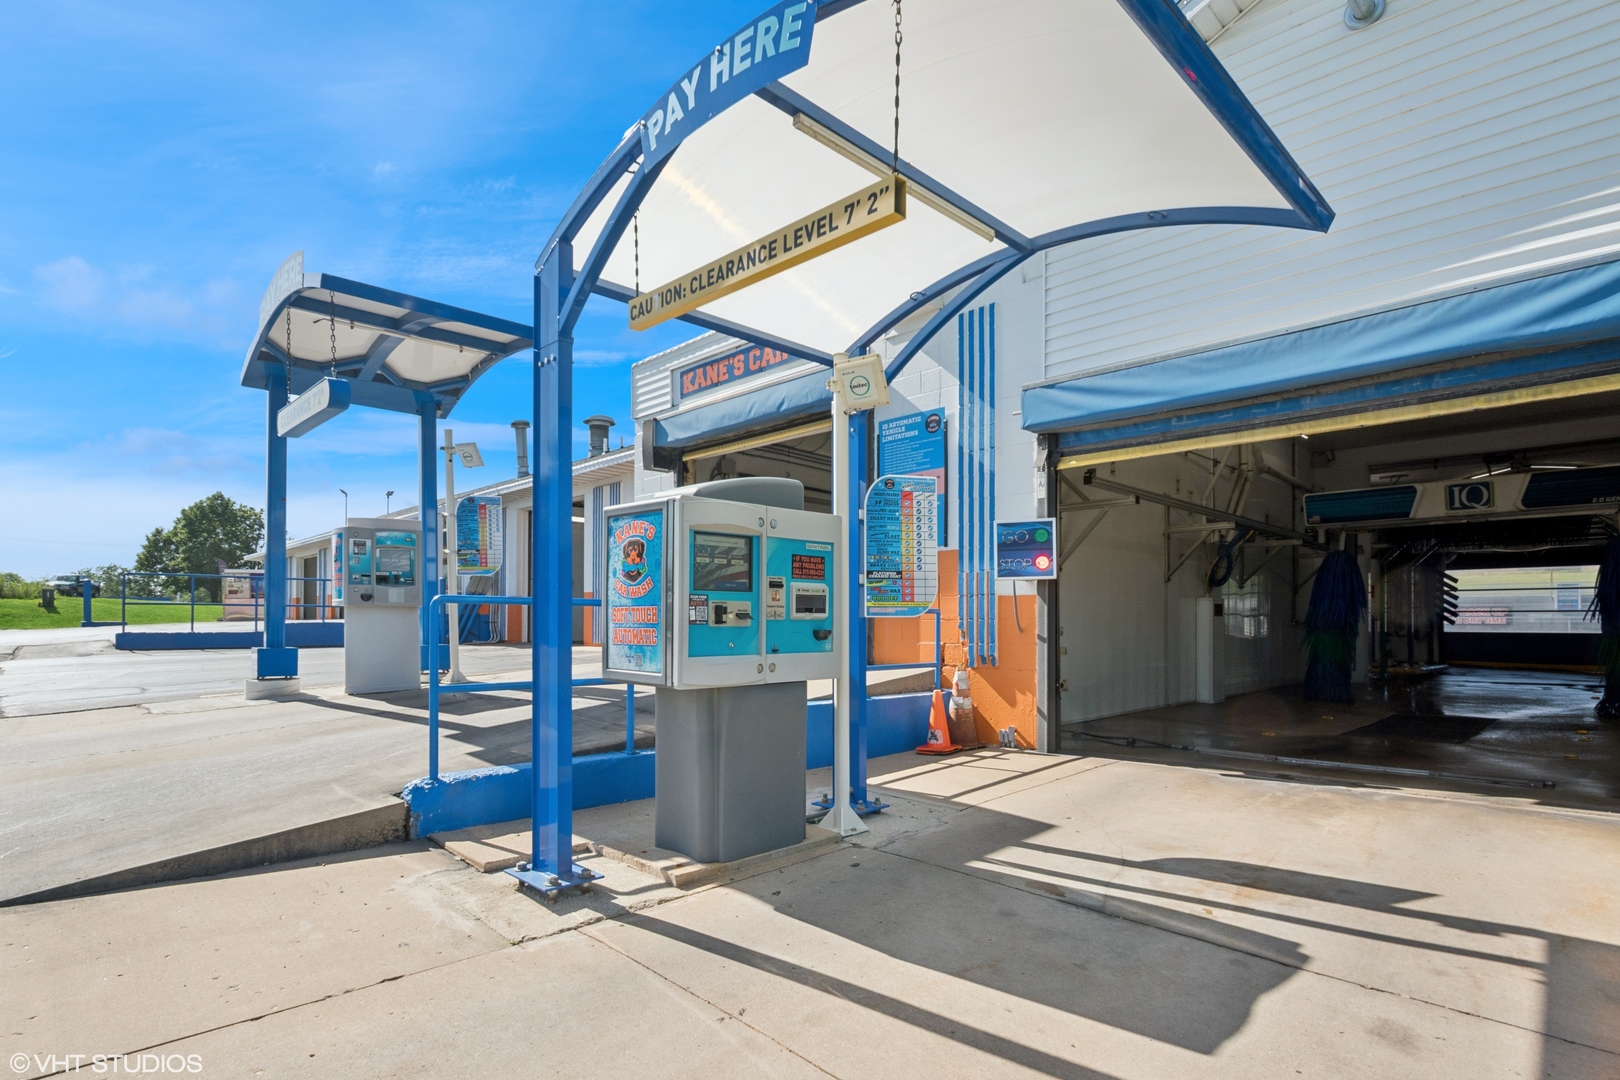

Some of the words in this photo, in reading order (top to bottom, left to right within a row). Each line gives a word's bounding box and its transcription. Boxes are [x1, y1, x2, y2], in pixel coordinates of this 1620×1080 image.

[646, 65, 702, 151] PAY
[710, 1, 807, 93] HERE
[690, 238, 778, 294] CLEARANCE
[783, 212, 839, 254] LEVEL
[277, 254, 303, 296] HERE
[682, 353, 745, 395] KANE'S
[850, 382, 868, 390] Unitec
[882, 426, 906, 436] VEHICLE
[889, 416, 922, 428] AUTOMATIC
[882, 430, 918, 442] LIMITATIONS
[1451, 484, 1491, 509] IQ
[614, 520, 656, 545] KANE'S
[1002, 530, 1028, 543] GO
[1000, 558, 1032, 570] STOP
[614, 578, 628, 597] CAR
[629, 576, 654, 599] WASH
[612, 606, 629, 624] SOFT
[630, 606, 658, 624] TOUCH
[612, 627, 658, 646] AUTOMATIC
